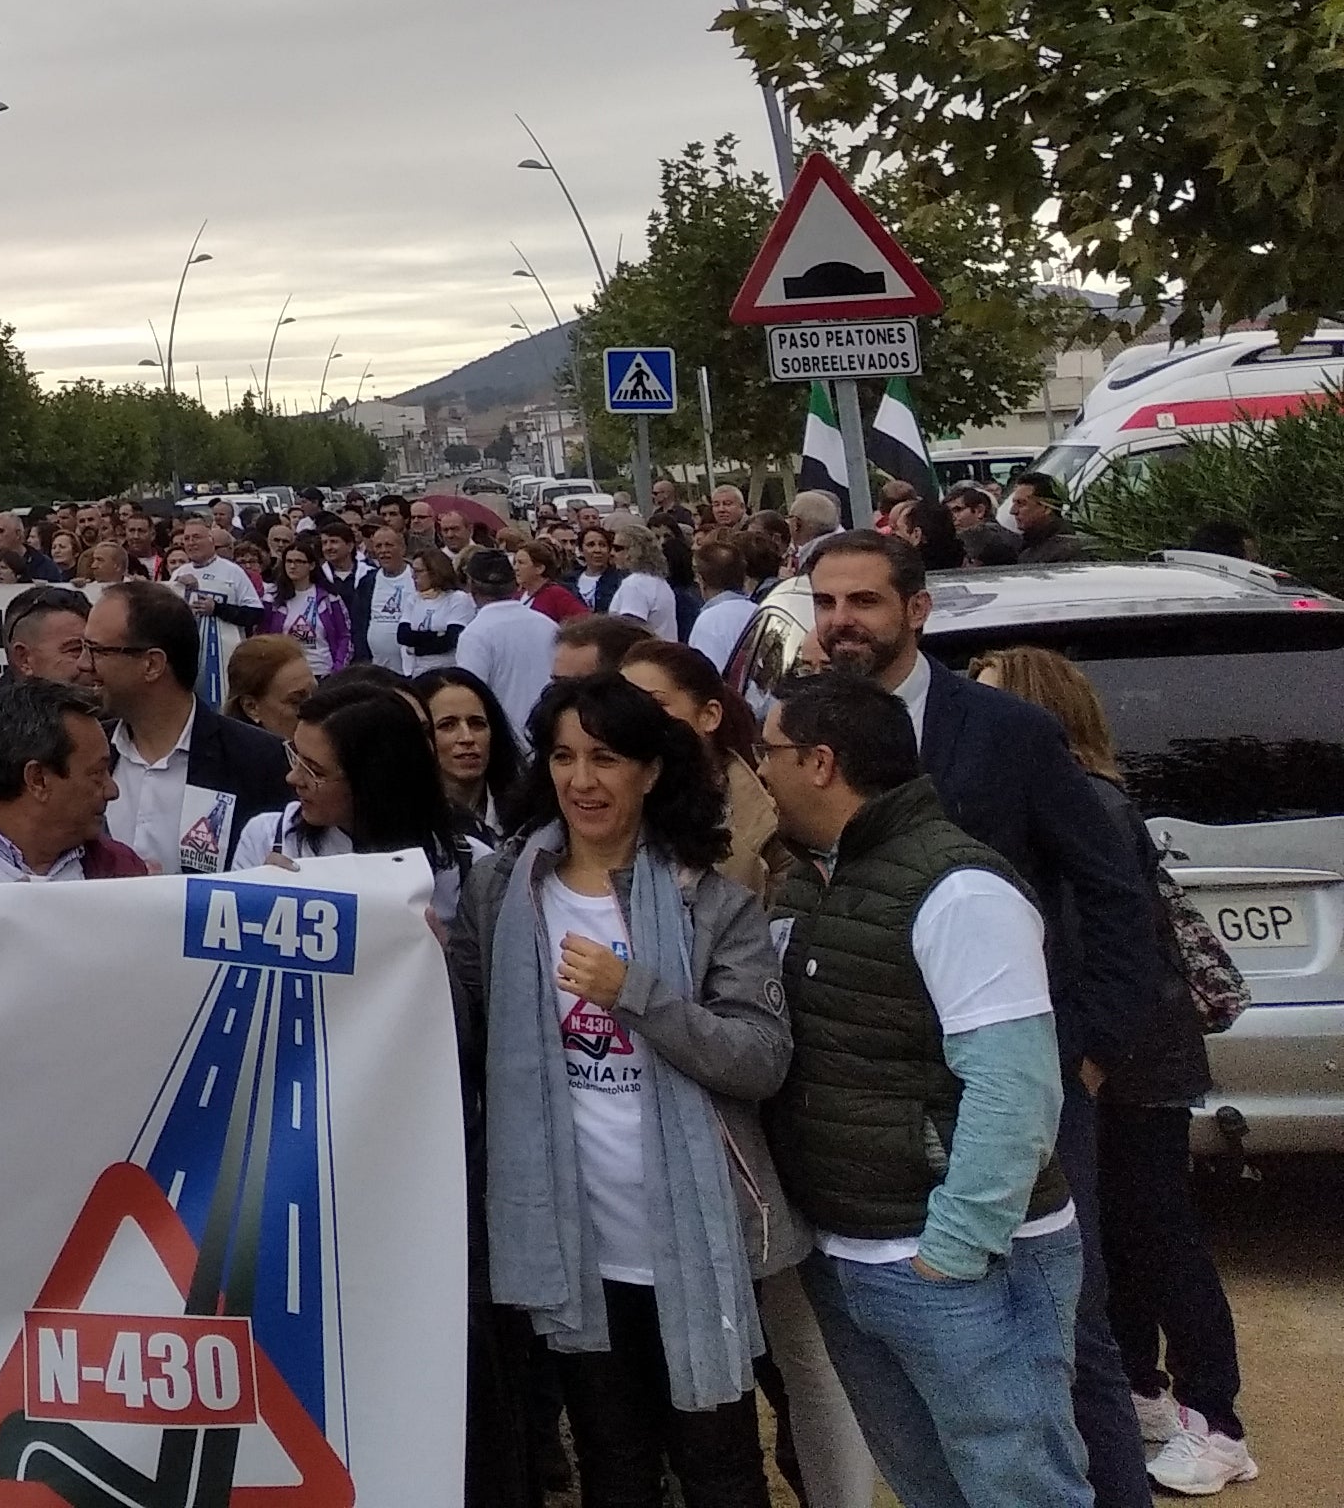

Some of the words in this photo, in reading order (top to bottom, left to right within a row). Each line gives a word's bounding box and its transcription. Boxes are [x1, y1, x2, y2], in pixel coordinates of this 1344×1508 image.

[778, 331, 820, 349] PASO
[825, 327, 907, 347] PEATONES
[781, 352, 910, 374] SOBREELEVADOS
[180, 848, 218, 867] NACIONAL
[202, 889, 339, 962] A-43
[1218, 906, 1293, 942] GGP
[570, 1016, 614, 1033] N-430
[37, 1326, 241, 1413] N-430
